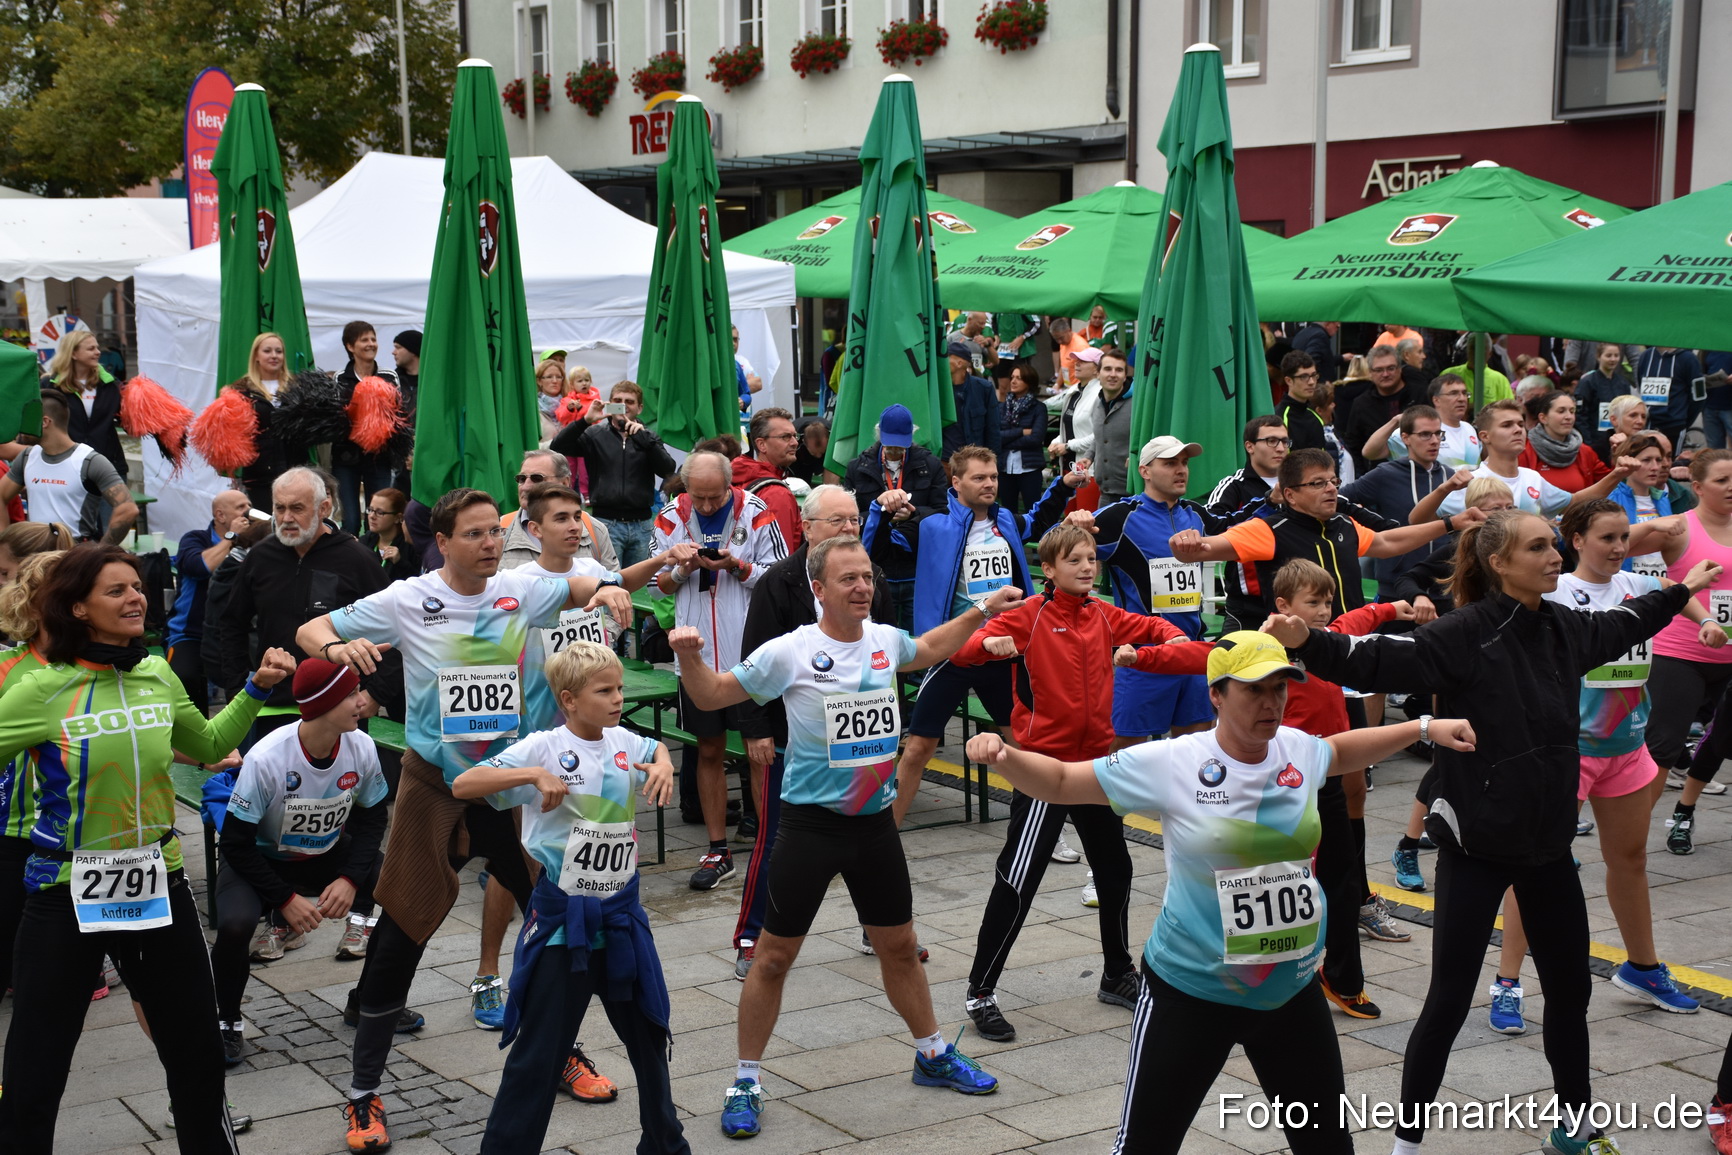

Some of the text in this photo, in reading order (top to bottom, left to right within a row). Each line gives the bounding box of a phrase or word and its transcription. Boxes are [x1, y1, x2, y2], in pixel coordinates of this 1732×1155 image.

[629, 109, 712, 155] RE
[972, 254, 1049, 267] Neumarkter
[1330, 249, 1463, 265] Neumarkter
[941, 263, 1045, 280] Lammsbräu
[1607, 266, 1732, 288] Lamms
[1642, 383, 1667, 395] 2216
[969, 555, 1010, 579] 2769
[1163, 569, 1196, 592] 194
[1169, 596, 1195, 606] Robert
[423, 614, 449, 623] PARTL
[440, 673, 507, 682] PARTL Neumarkt
[1611, 668, 1633, 679] Anna
[449, 683, 514, 713] 2082
[826, 697, 887, 710] PARTL Neumarkt
[61, 703, 173, 742] BOCK
[469, 718, 498, 731] David
[834, 706, 895, 741] 2629
[851, 742, 884, 757] Patrick
[1196, 790, 1229, 800] PARTL
[1196, 798, 1230, 806] Neumarkt
[314, 800, 346, 811] Neumarkt
[290, 806, 347, 834] 2592
[573, 826, 602, 839] PARTL
[75, 853, 151, 866] PARTL Neumarkt
[573, 841, 635, 873] 4007
[81, 863, 158, 900] 2791
[1220, 870, 1302, 890] PARTL Neumarkt
[101, 906, 142, 919] Andrea
[1232, 883, 1315, 931] 5103
[1260, 935, 1299, 952] Peggy
